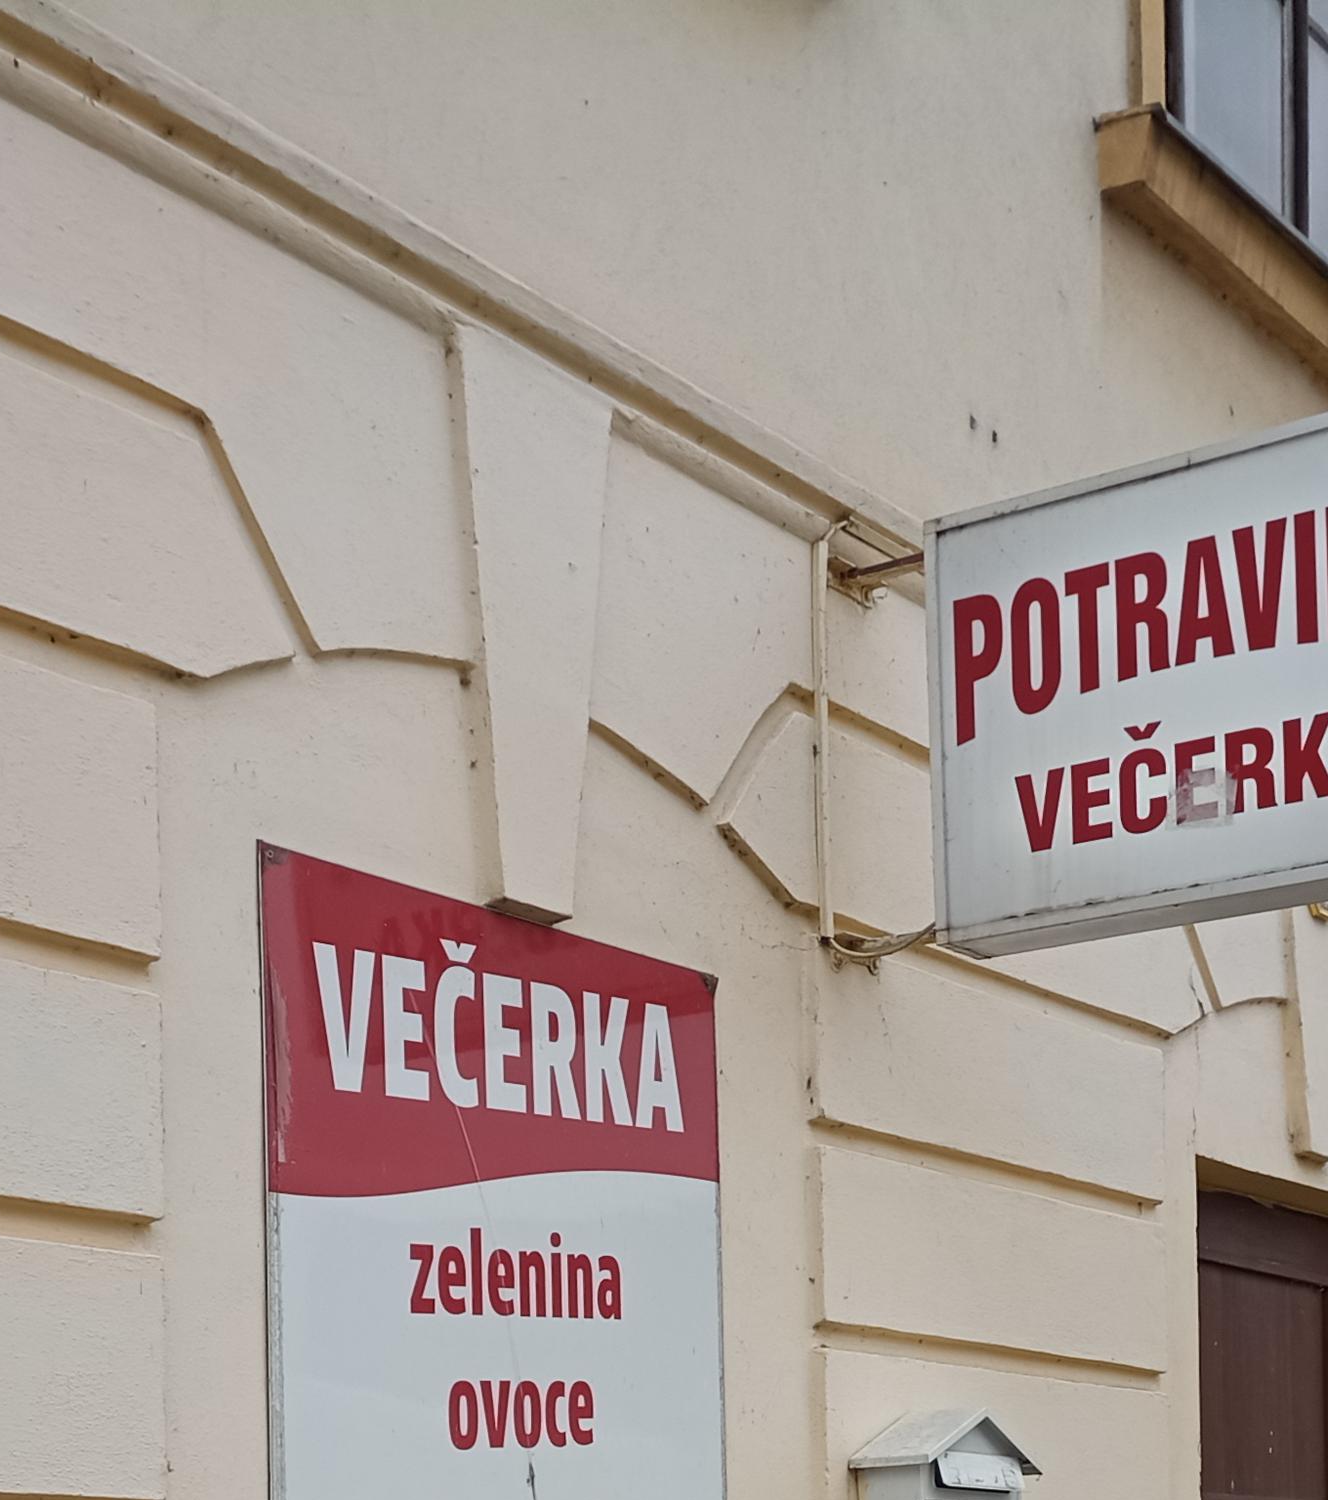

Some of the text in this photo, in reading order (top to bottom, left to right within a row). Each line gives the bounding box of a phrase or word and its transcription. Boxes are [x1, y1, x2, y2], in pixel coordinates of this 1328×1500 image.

[312, 938, 684, 1133] VEČERKA
[409, 1227, 622, 1320] zelenina
[448, 1379, 595, 1450] ovoce
